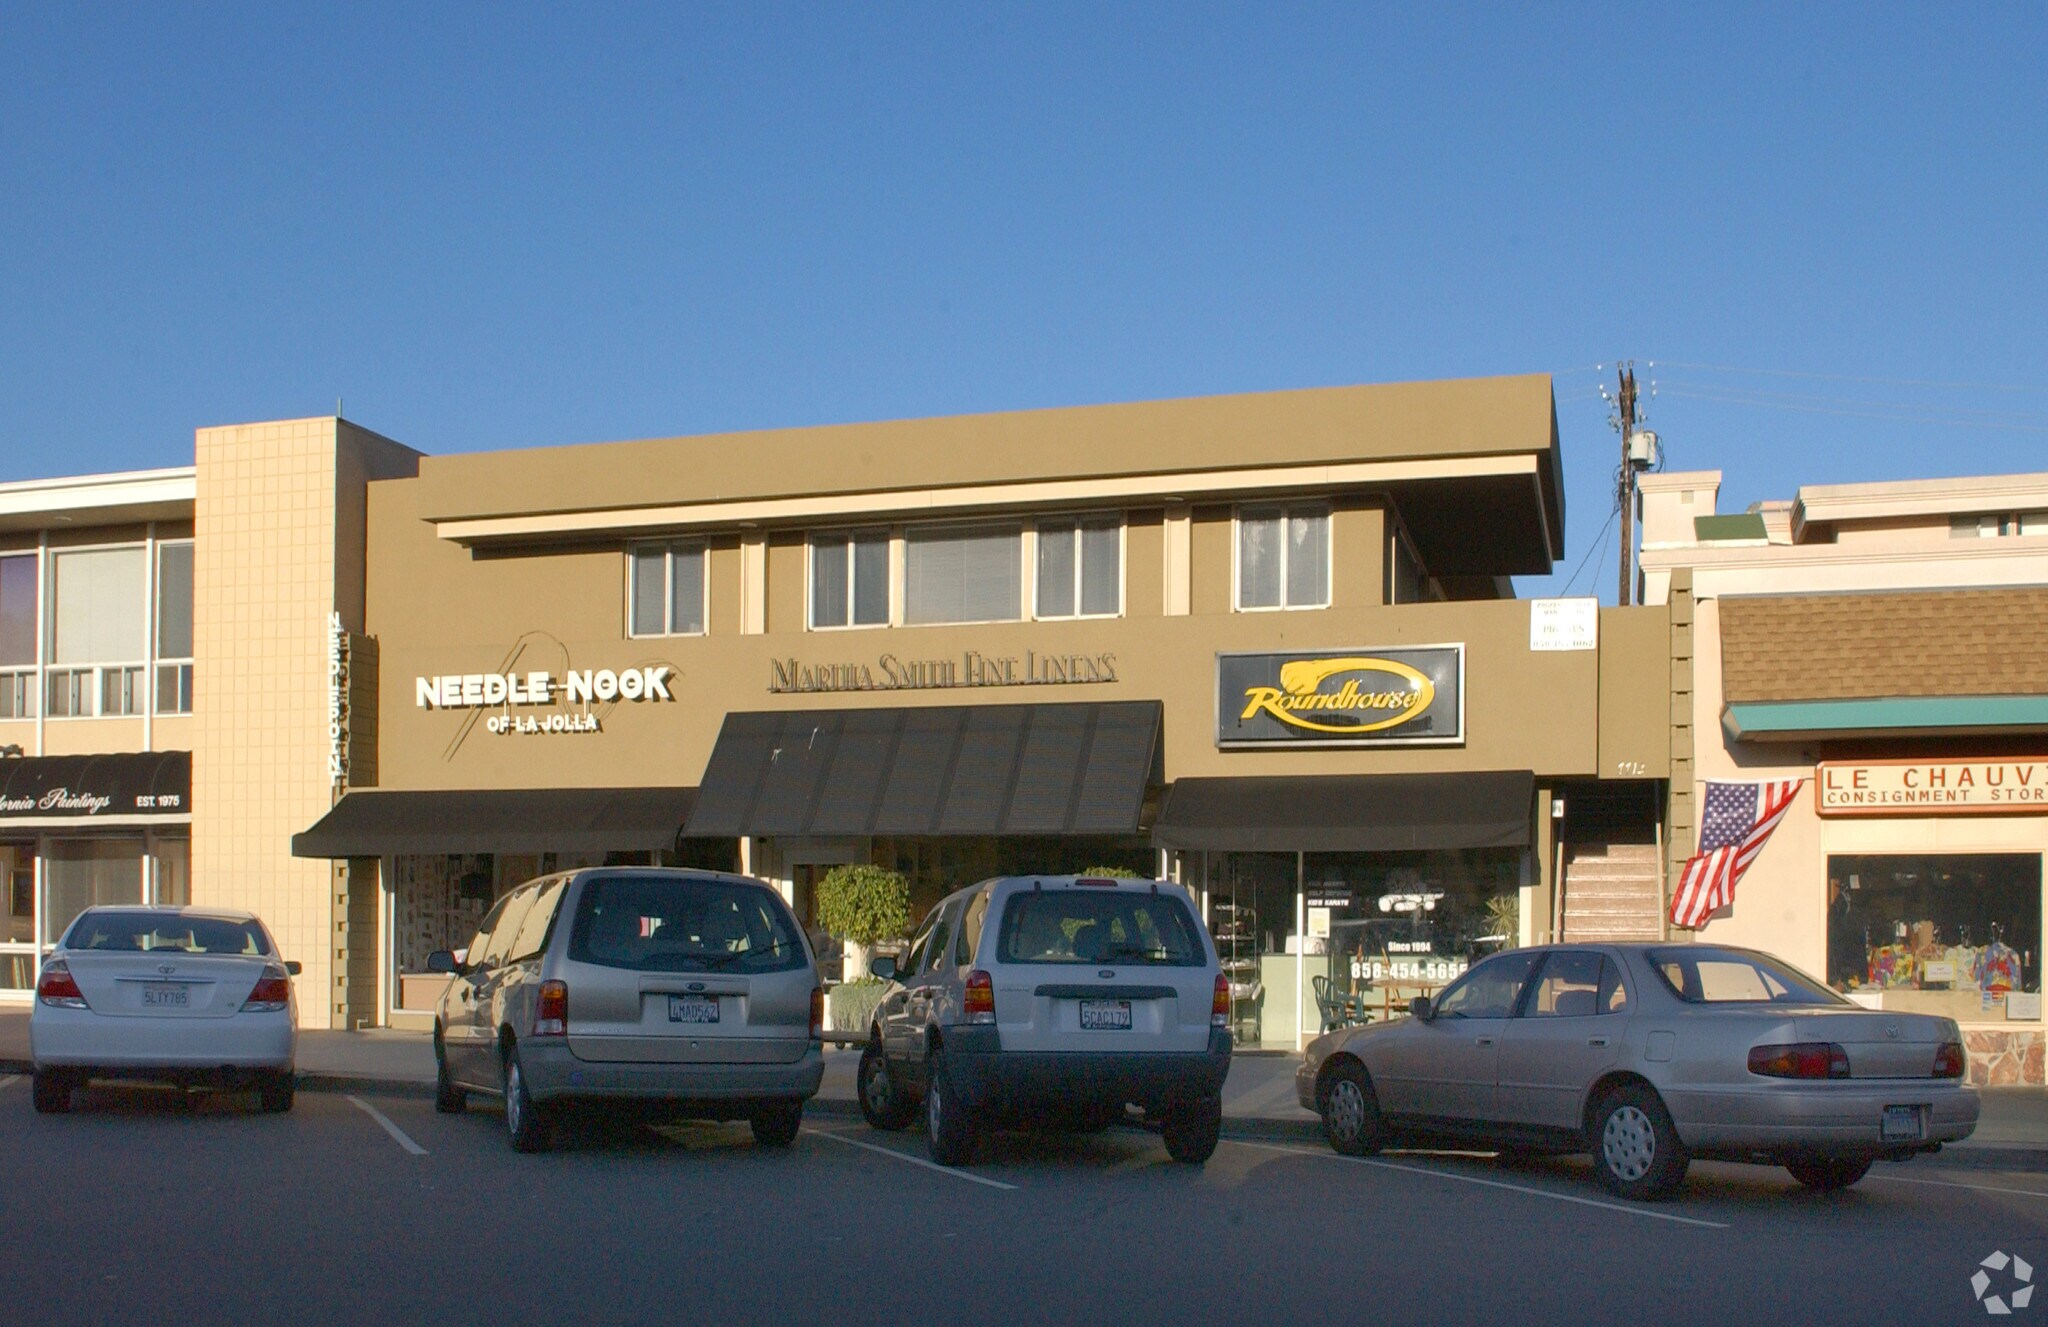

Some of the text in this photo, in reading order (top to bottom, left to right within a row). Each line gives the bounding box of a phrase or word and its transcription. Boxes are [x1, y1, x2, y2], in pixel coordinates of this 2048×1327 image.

[963, 651, 1018, 686] FINE
[1024, 650, 1118, 683] LINENS
[416, 667, 669, 707] NEEDLE NOOK
[1240, 678, 1421, 720] Roundhouse
[487, 713, 597, 732] OF LA JOLLA
[1827, 766, 2048, 789] LE CHAUV
[39, 786, 111, 815] Paintings
[1827, 789, 1971, 804] CONSIGNMENT
[1388, 941, 1410, 952] Since
